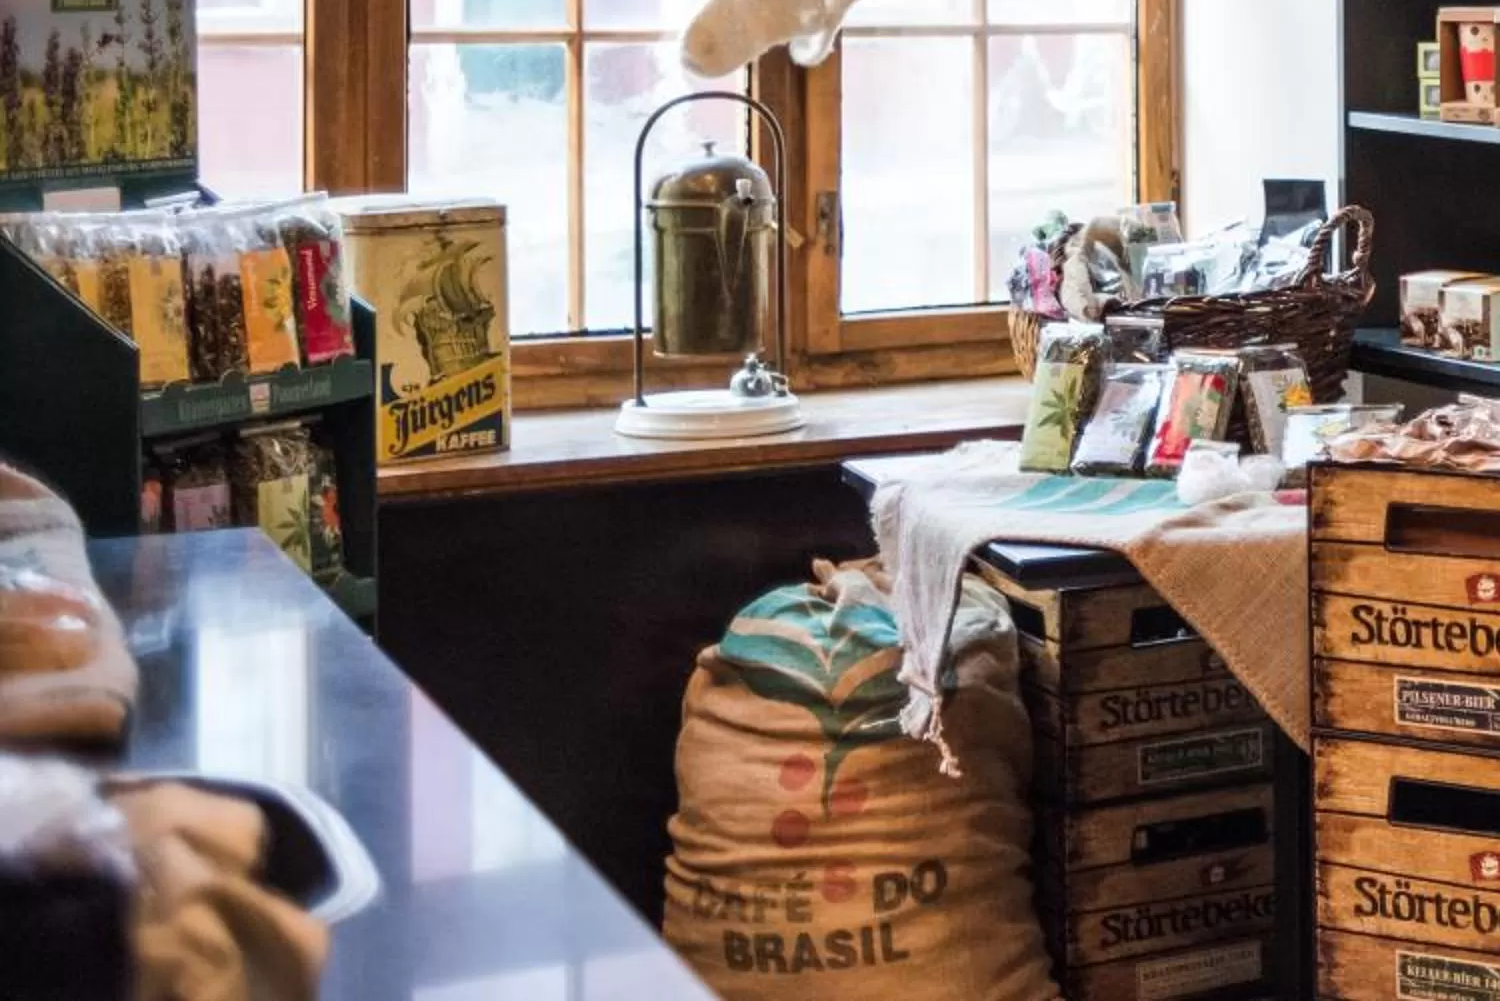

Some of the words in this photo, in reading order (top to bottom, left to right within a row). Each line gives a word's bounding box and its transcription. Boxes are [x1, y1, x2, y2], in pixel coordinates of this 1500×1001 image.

[388, 373, 496, 456] Jürgens
[435, 430, 497, 452] KAFFEE
[1100, 679, 1257, 729] Störtebe
[872, 858, 947, 911] DO
[1100, 891, 1279, 947] Störtebeke
[722, 921, 911, 974] BRASIL
